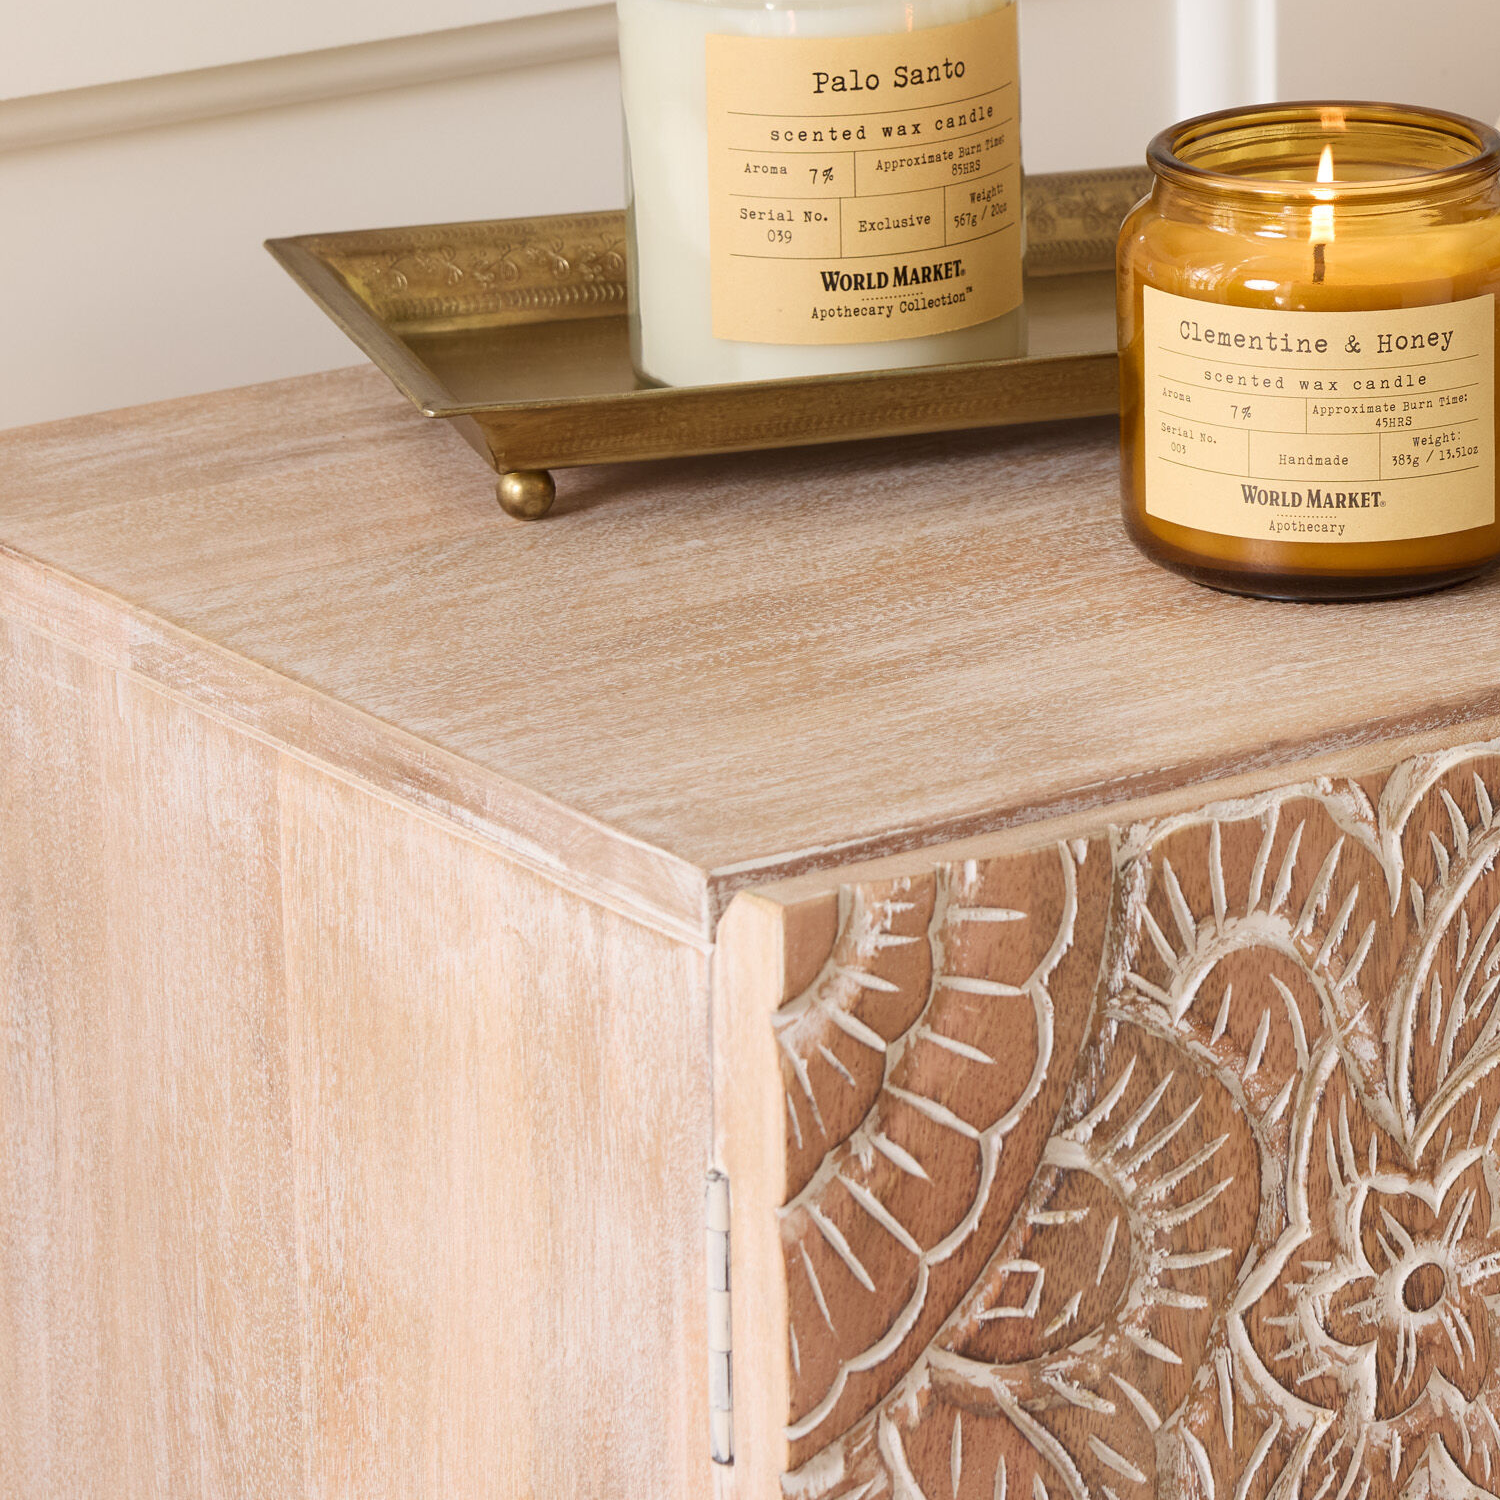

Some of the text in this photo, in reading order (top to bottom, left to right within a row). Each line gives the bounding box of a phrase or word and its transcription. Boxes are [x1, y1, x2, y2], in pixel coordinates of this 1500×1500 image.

[813, 57, 966, 93] Palo Santo
[771, 104, 994, 142] scented wax candle
[876, 149, 954, 171] Approximate
[959, 143, 982, 159] Burn
[744, 163, 787, 174] Aroma
[809, 167, 834, 184] 7%
[951, 160, 981, 176] 85HRS
[740, 208, 828, 222] Serial No.
[858, 214, 930, 233] Exclusive
[954, 214, 977, 228] 567g
[767, 229, 792, 243] 039
[811, 304, 893, 321] Apothecary
[1180, 320, 1454, 354] Clementine & Honey
[1204, 370, 1428, 391] scented wax candle
[1162, 388, 1191, 403] Aroma
[1230, 405, 1252, 420] 7%
[1313, 393, 1468, 416] Approximate Burn Time:
[1375, 417, 1412, 428] 45HRS
[1161, 422, 1217, 444] Serial No.
[1412, 430, 1461, 448] Weight:
[1279, 454, 1349, 466] Handmade
[1392, 454, 1420, 468] 383g
[1439, 446, 1479, 461] 13.51oz
[1269, 520, 1345, 536] Apothecary
